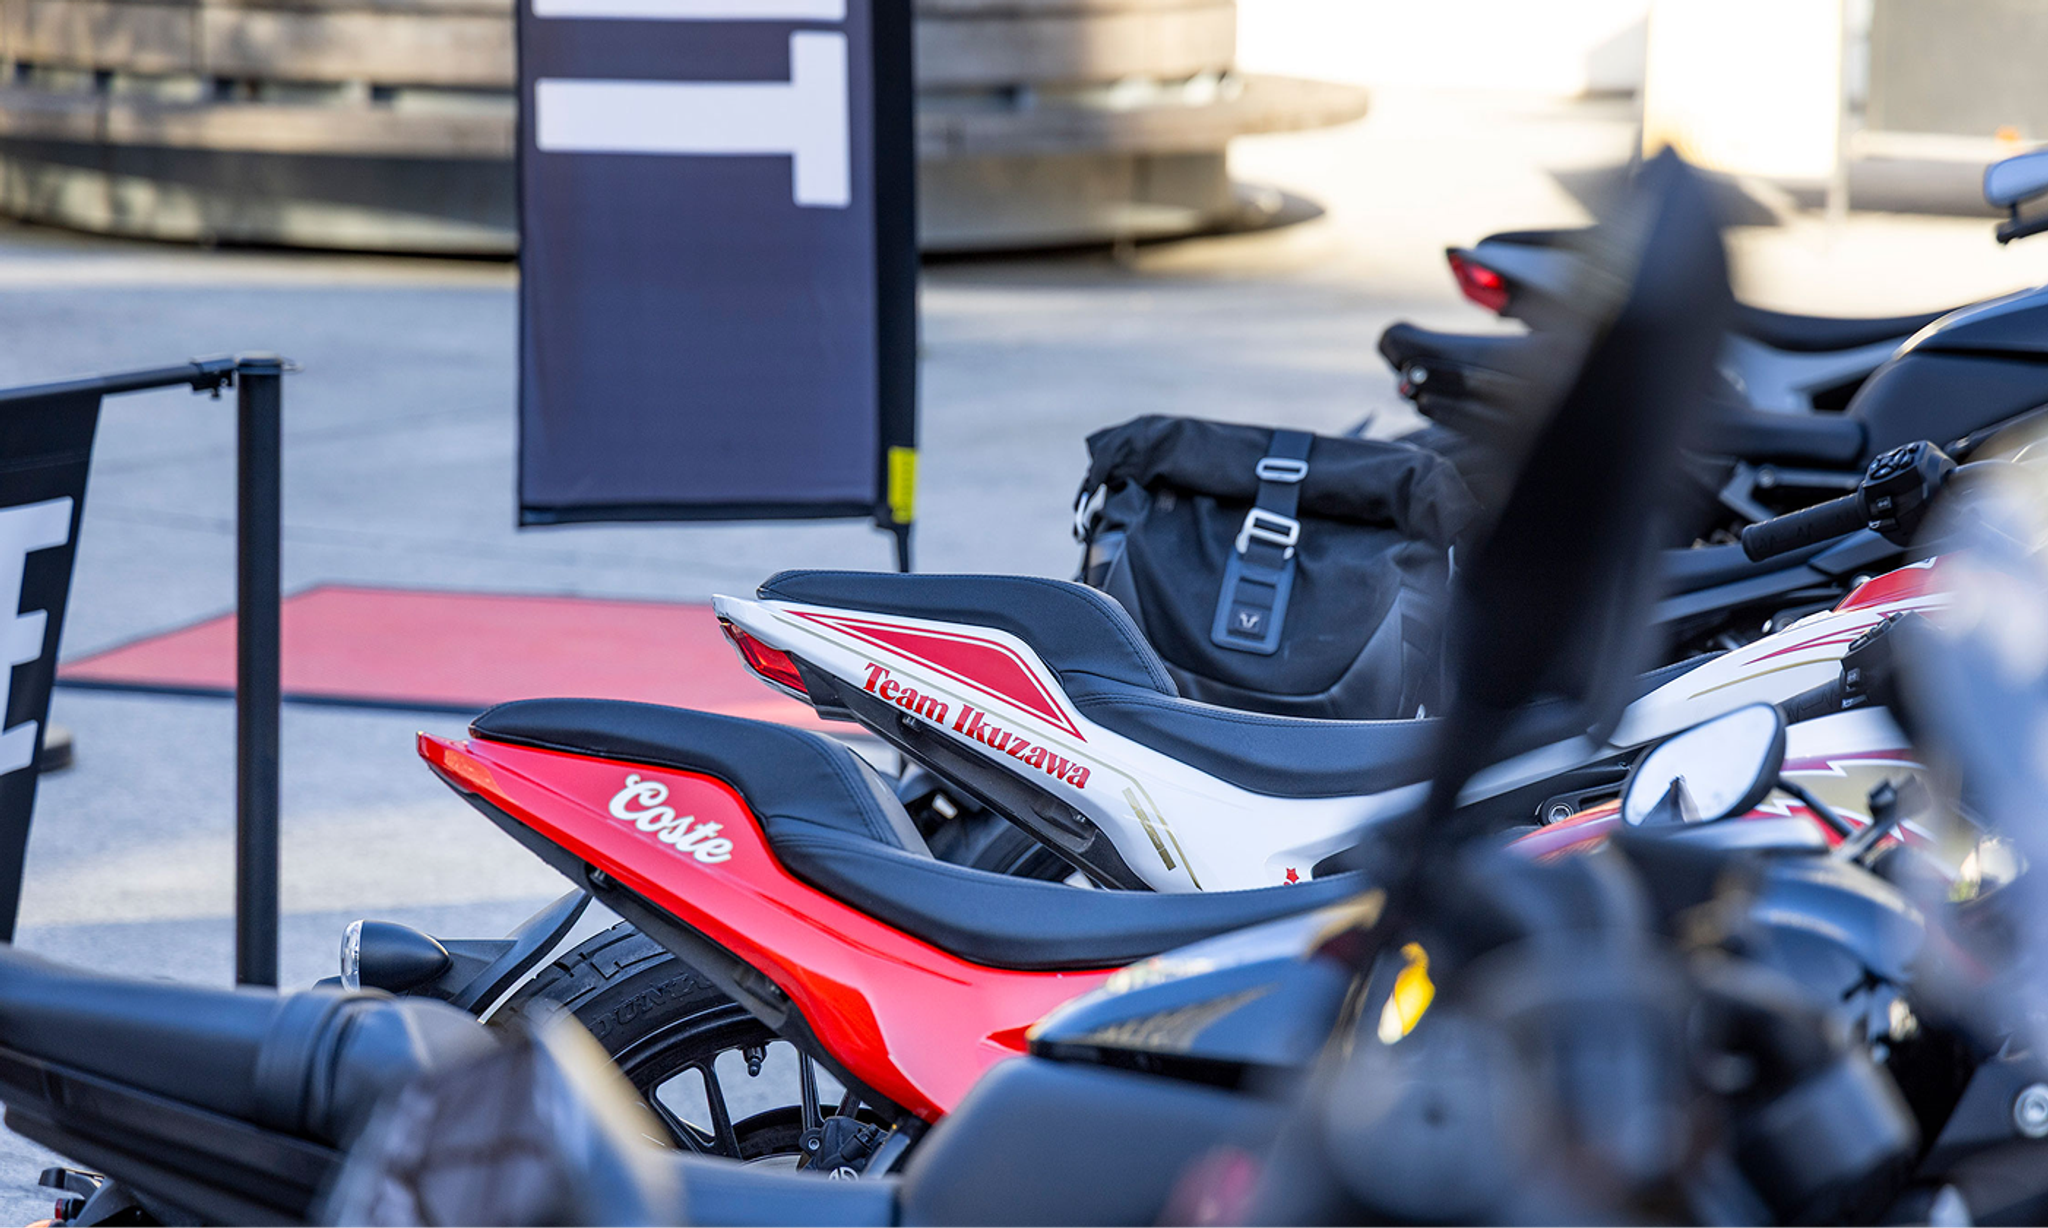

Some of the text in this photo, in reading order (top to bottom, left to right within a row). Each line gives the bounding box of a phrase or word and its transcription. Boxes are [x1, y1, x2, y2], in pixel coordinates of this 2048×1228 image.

[532, 0, 851, 208] T
[862, 661, 1092, 790] Team Ikuzawa
[607, 773, 734, 864] Coste
